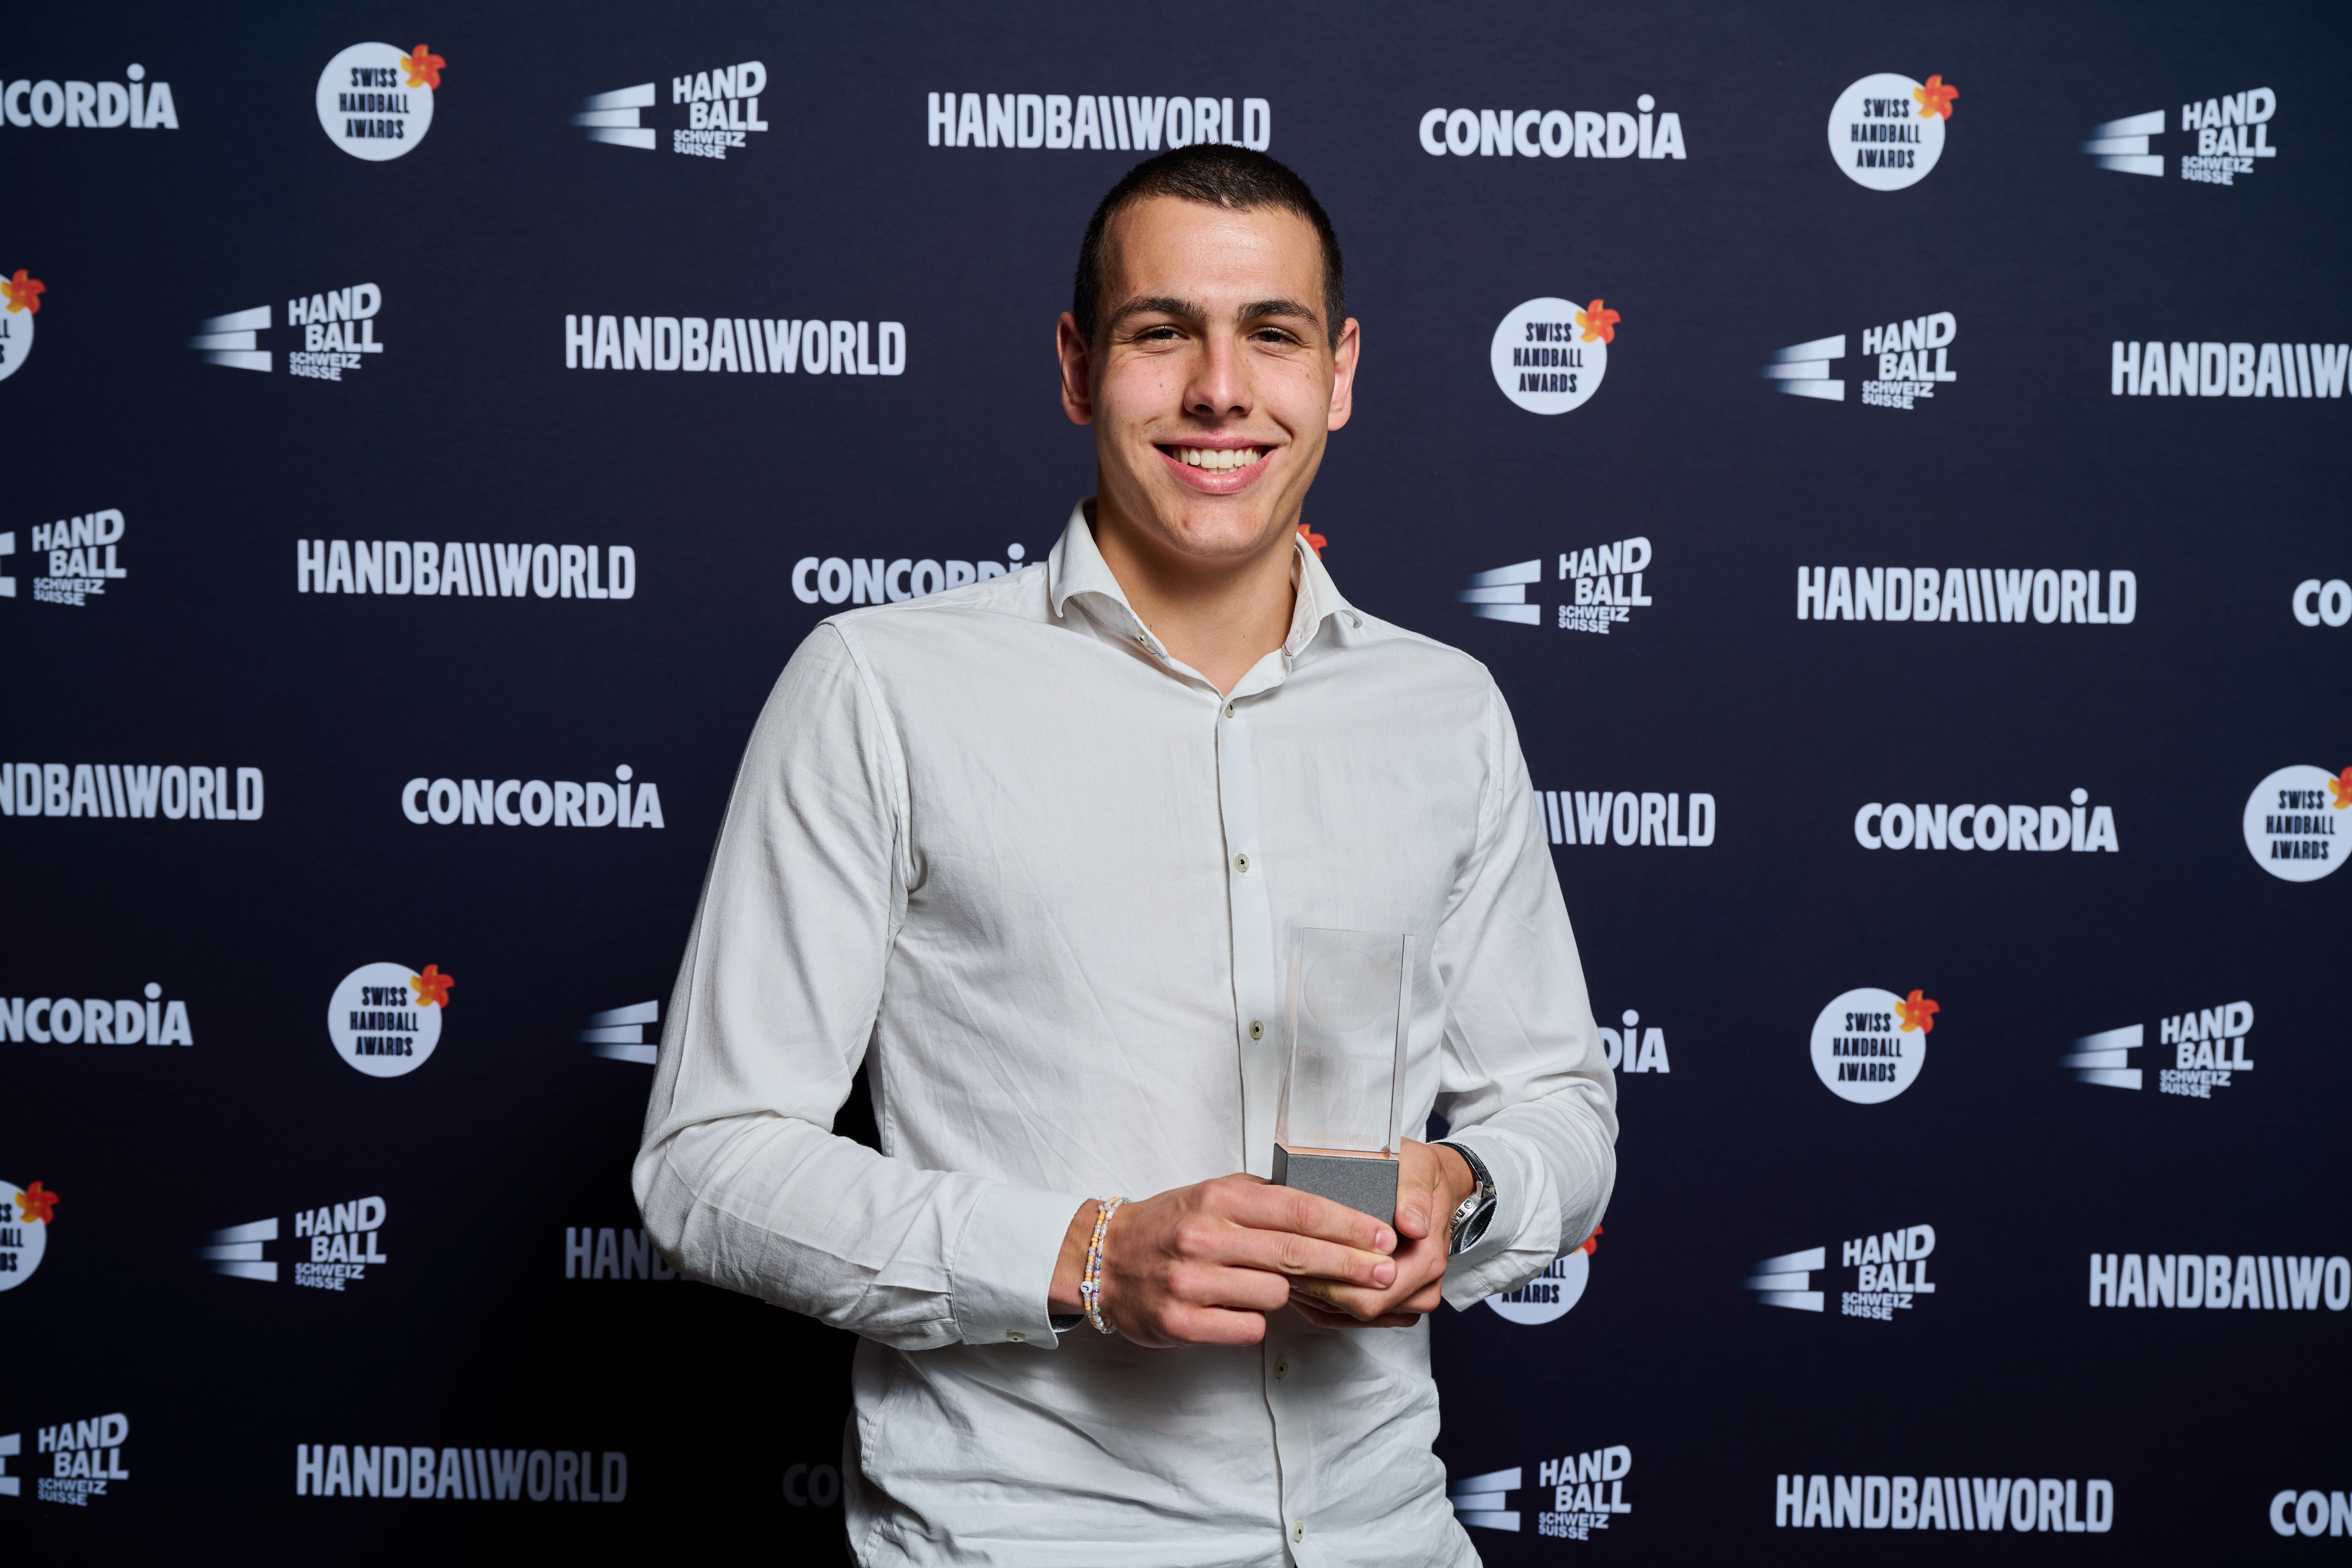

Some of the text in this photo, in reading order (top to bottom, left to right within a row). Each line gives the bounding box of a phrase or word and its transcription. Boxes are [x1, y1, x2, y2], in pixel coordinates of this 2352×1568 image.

[352, 67, 397, 88] SWISS
[673, 60, 767, 104] HAND
[0, 63, 179, 129] CORDiA
[340, 93, 409, 113] HANDBALL
[690, 98, 768, 131] BALL
[1863, 98, 1909, 118] SWISS
[2181, 87, 2276, 132] HAND
[346, 119, 403, 139] AWARDS
[673, 129, 745, 147] SCHWEIZ
[1851, 124, 1921, 143] HANDBALL
[673, 143, 725, 159] SUISSE
[2198, 125, 2276, 157] BALL
[1857, 149, 1915, 168] AWARDS
[2181, 156, 2254, 174] SCHWEIZ
[2181, 169, 2233, 186] SUISSE
[288, 282, 382, 327] HAND
[305, 319, 384, 352] BALL
[1526, 322, 1572, 342] SWISS
[1862, 311, 1957, 355] HAND
[289, 351, 361, 368] SCHWEIZ
[1514, 348, 1583, 367] HANDBALL
[1878, 349, 1957, 382] BALL
[289, 364, 341, 381] SUISSE
[1519, 373, 1577, 393] AWARDS
[1861, 381, 1934, 398] SCHWEIZ
[1861, 393, 1913, 410] SUISSE
[31, 509, 125, 552] HAND
[48, 545, 127, 579] BALL
[1558, 536, 1652, 581] HAND
[33, 577, 105, 593] SCHWEIZ
[1575, 574, 1652, 606] BALL
[33, 589, 84, 606] SUISSE
[1558, 605, 1630, 621] SCHWEIZ
[1558, 617, 1609, 634] SUISSE
[2278, 790, 2324, 810] SWISS
[2266, 815, 2335, 835] HANDBALL
[2271, 840, 2328, 860] AWARDS
[362, 986, 407, 1007] SWISS
[350, 1011, 419, 1032] HANDBALL
[1846, 1012, 1891, 1032] SWISS
[2160, 1000, 2254, 1044] HAND
[355, 1036, 413, 1056] AWARDS
[1833, 1037, 1902, 1057] HANDBALL
[2176, 1037, 2254, 1070] BALL
[1838, 1063, 1896, 1082] AWARDS
[2159, 1069, 2231, 1087] SCHWEIZ
[2159, 1081, 2210, 1100] SUISSE
[295, 1195, 386, 1238] HAND
[310, 1231, 387, 1264] BALL
[1842, 1223, 1936, 1268] HAND
[294, 1262, 365, 1279] SCHWEIZ
[1858, 1261, 1936, 1293] BALL
[294, 1275, 344, 1292] SUISSE
[1841, 1292, 1913, 1309] SCHWEIZ
[1841, 1303, 1893, 1321] SUISSE
[38, 1413, 129, 1455] HAND
[53, 1447, 130, 1480] BALL
[1539, 1444, 1632, 1488] HAND
[37, 1478, 107, 1495] SCHWEIZ
[37, 1490, 88, 1506] SUISSE
[1554, 1480, 1632, 1514] BALL
[1538, 1512, 1609, 1529] SCHWEIZ
[1538, 1524, 1589, 1541] SUISSE
